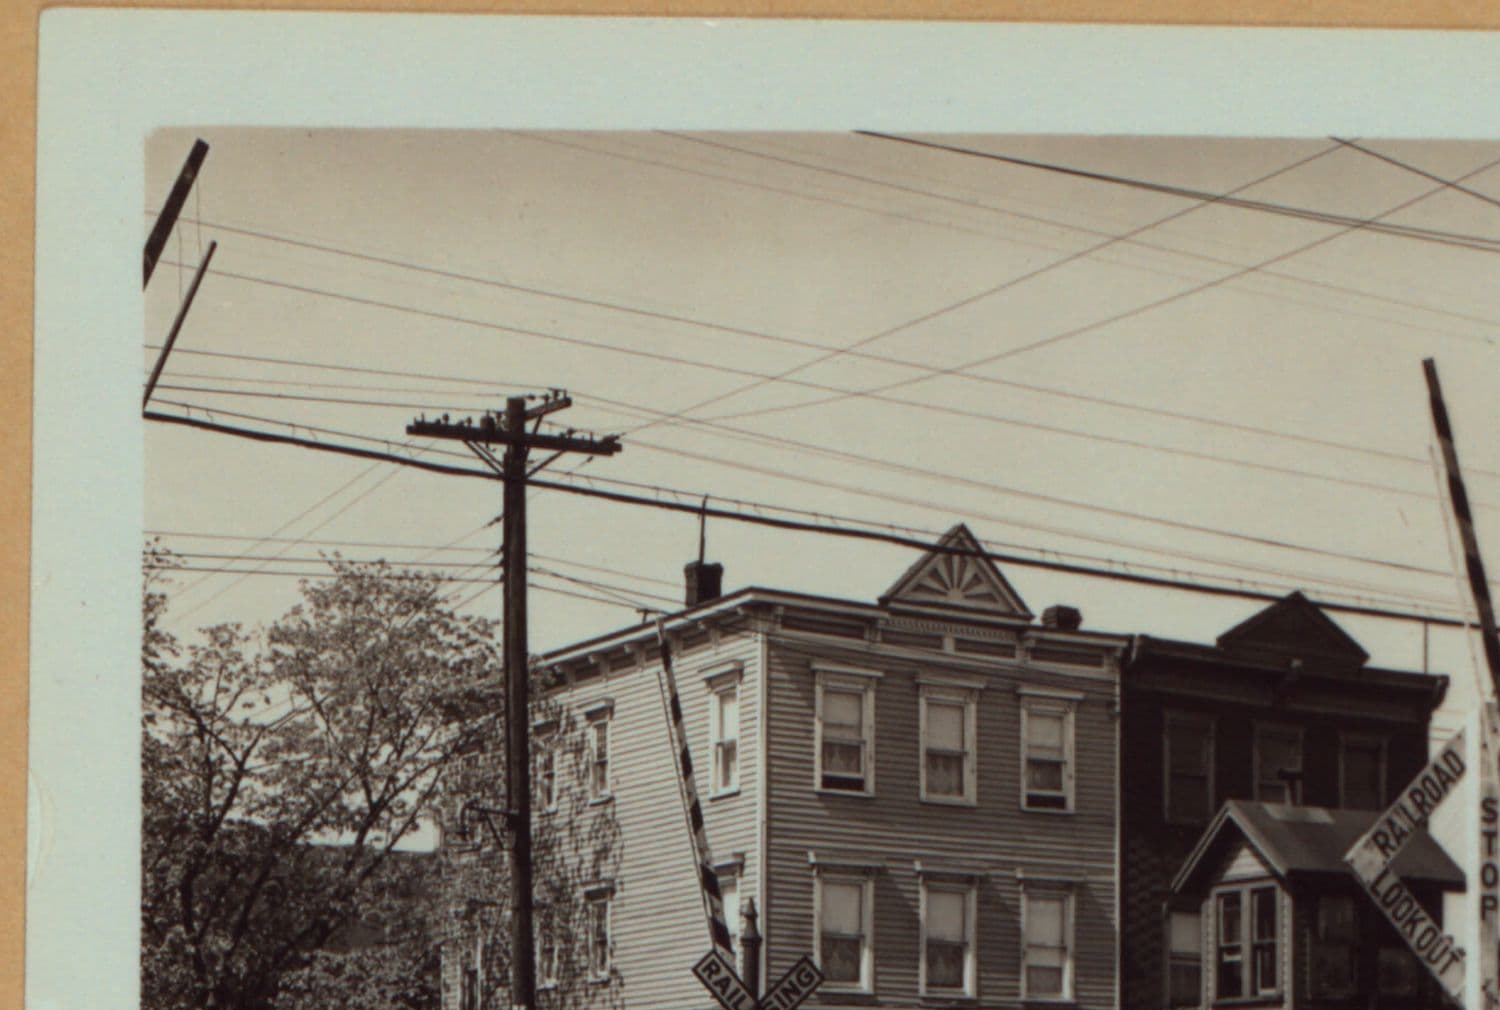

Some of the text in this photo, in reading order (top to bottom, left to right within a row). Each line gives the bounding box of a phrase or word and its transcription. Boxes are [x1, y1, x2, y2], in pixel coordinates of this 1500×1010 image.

[1372, 748, 1466, 858] RAILROAD
[1481, 797, 1498, 921] STOP
[1369, 868, 1466, 976] LOOKOUT
